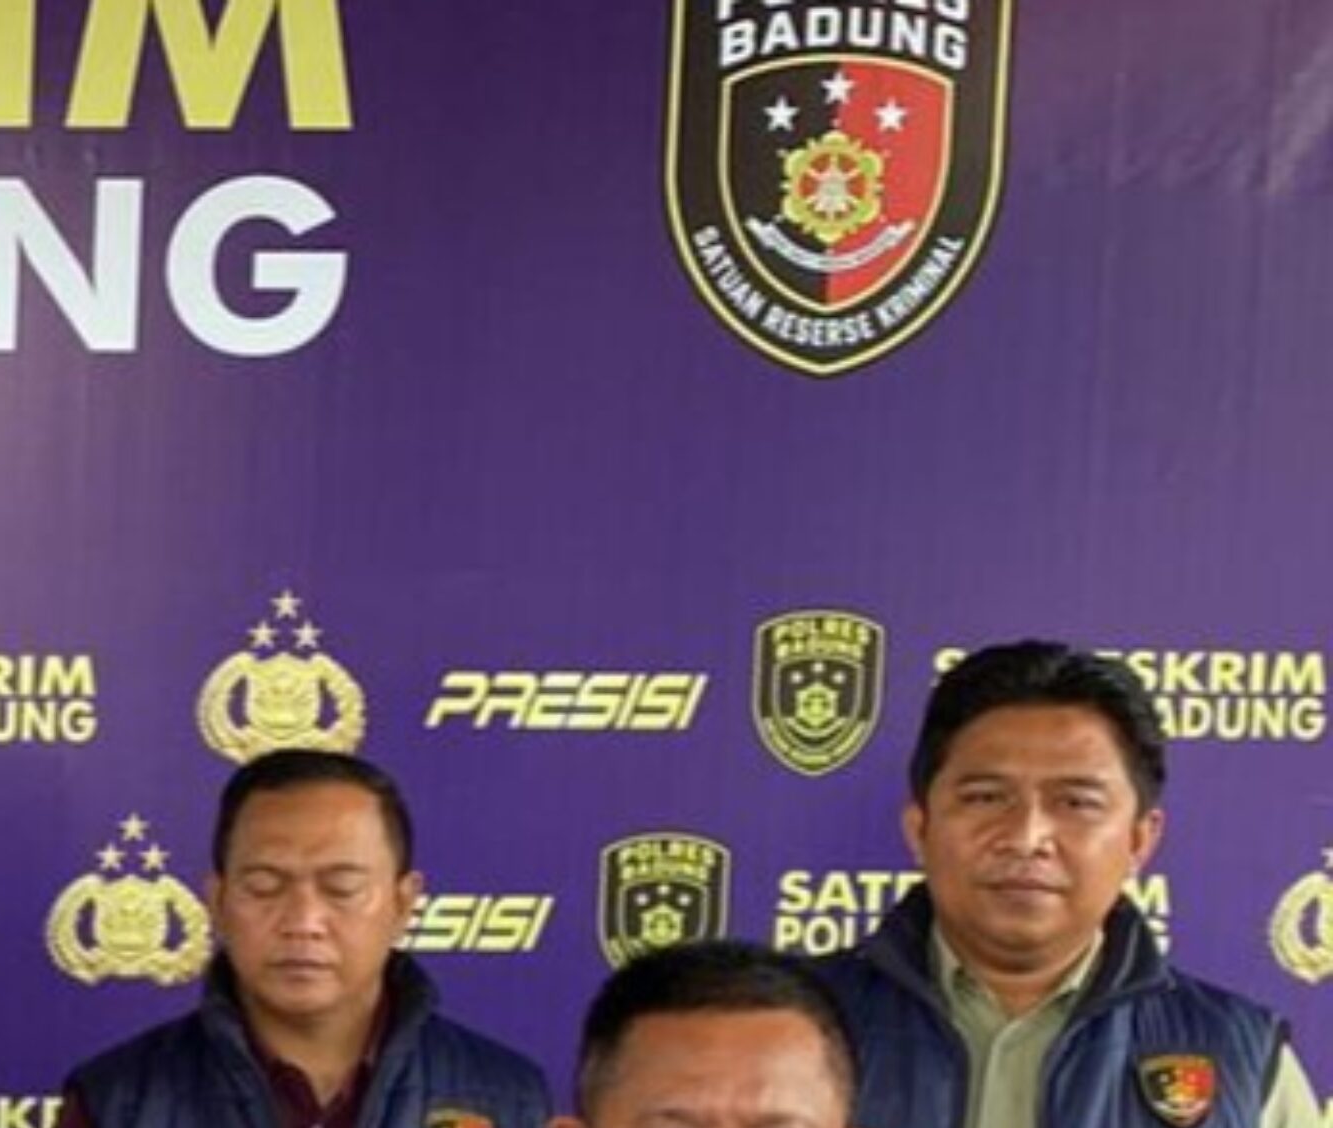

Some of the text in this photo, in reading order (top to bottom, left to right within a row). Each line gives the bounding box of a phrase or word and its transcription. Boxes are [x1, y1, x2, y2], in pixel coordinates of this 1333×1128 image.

[719, 7, 968, 68] BADUNG
[425, 672, 708, 730] PRESISI
[393, 894, 554, 951] SISI
